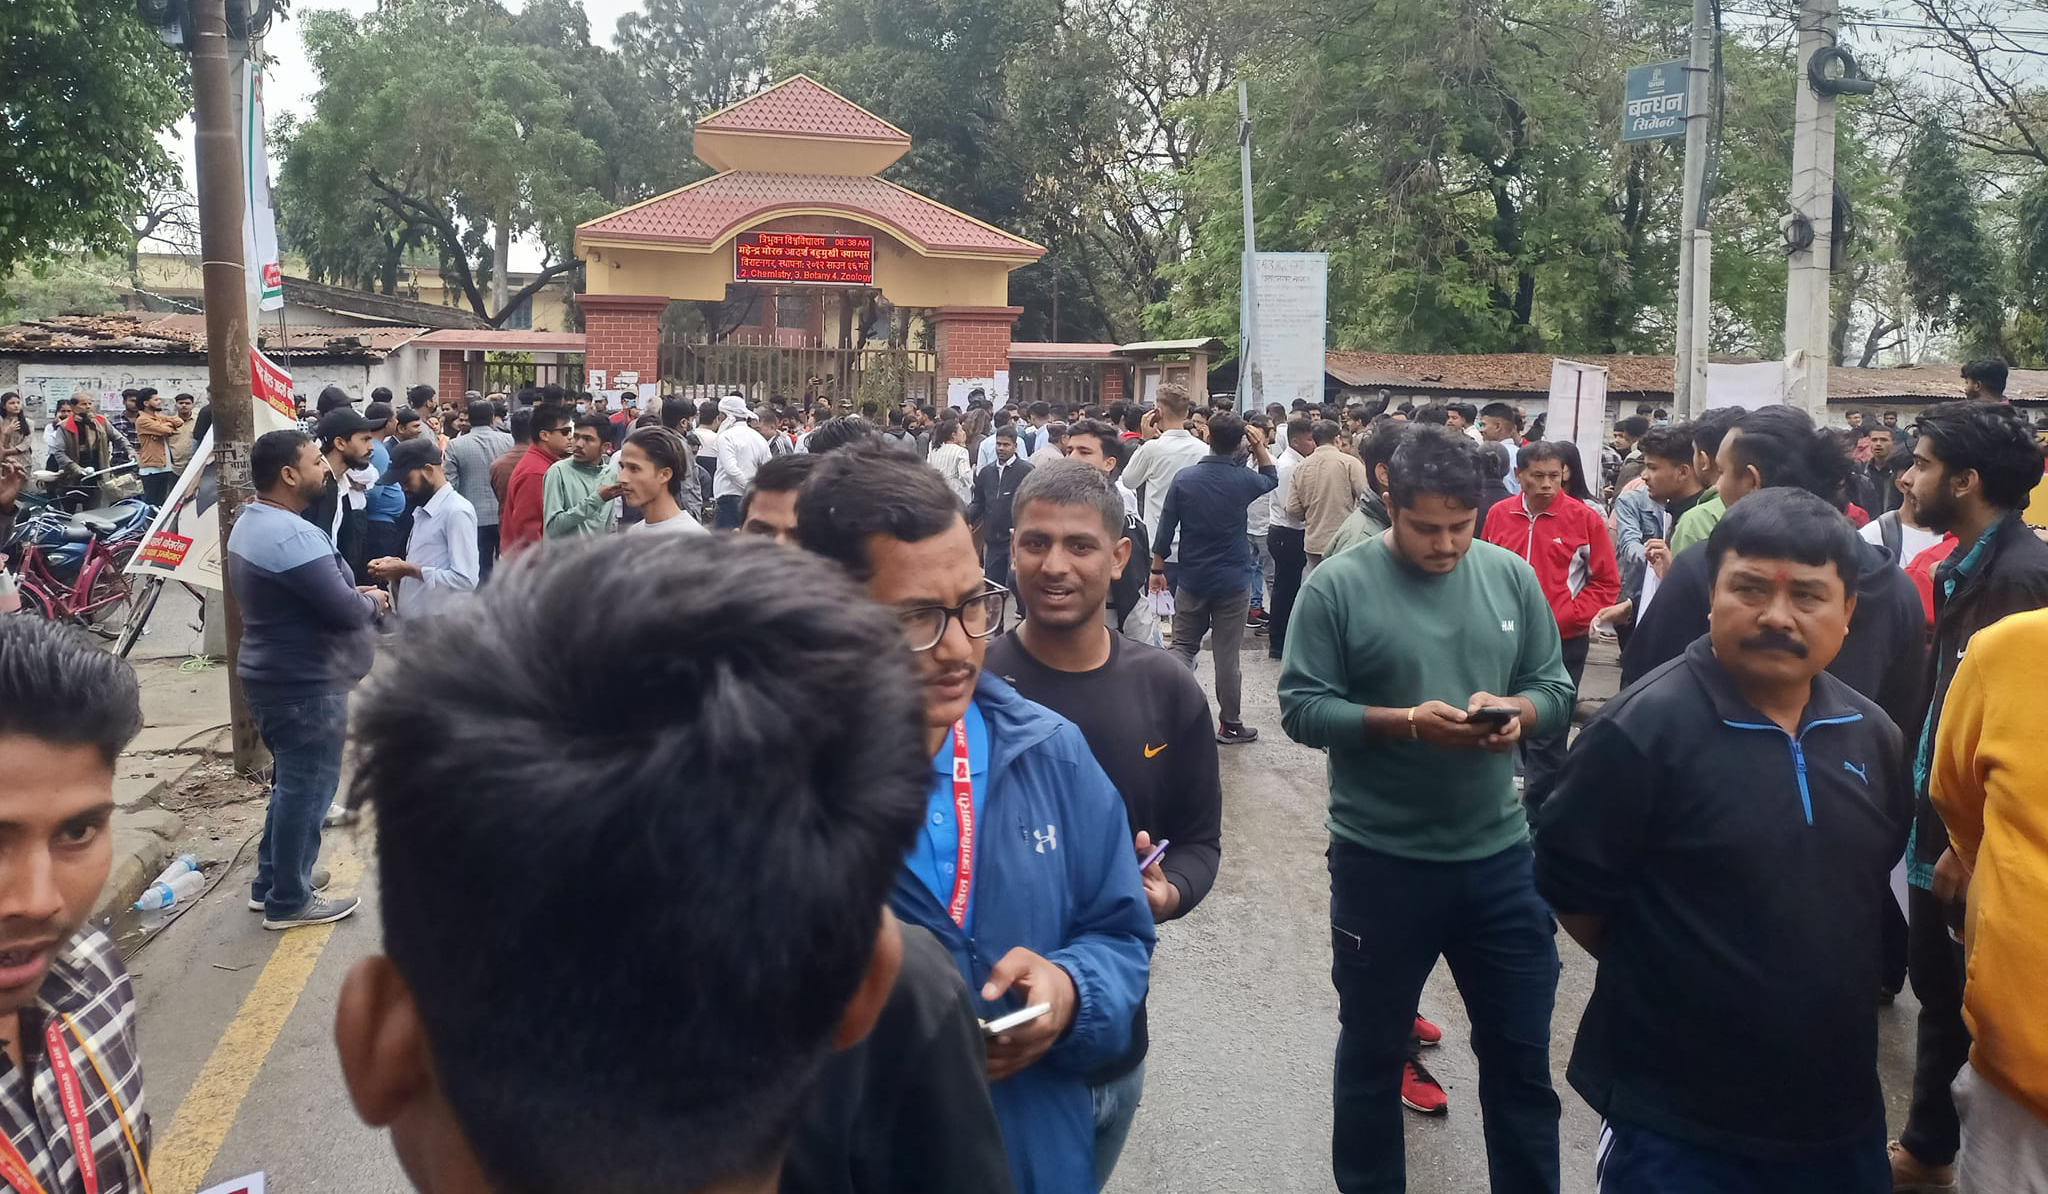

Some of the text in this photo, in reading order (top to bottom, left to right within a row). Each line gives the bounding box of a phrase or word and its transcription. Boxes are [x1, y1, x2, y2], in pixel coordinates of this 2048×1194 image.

[1628, 93, 1685, 116] बन्धन
[758, 234, 784, 246] त्रिभुवन
[785, 234, 825, 246] विश्वविद्यालय
[857, 239, 870, 247] AM
[738, 244, 761, 256] महेन्द्र
[784, 246, 808, 257] आदर्श
[840, 272, 871, 282] Zoology
